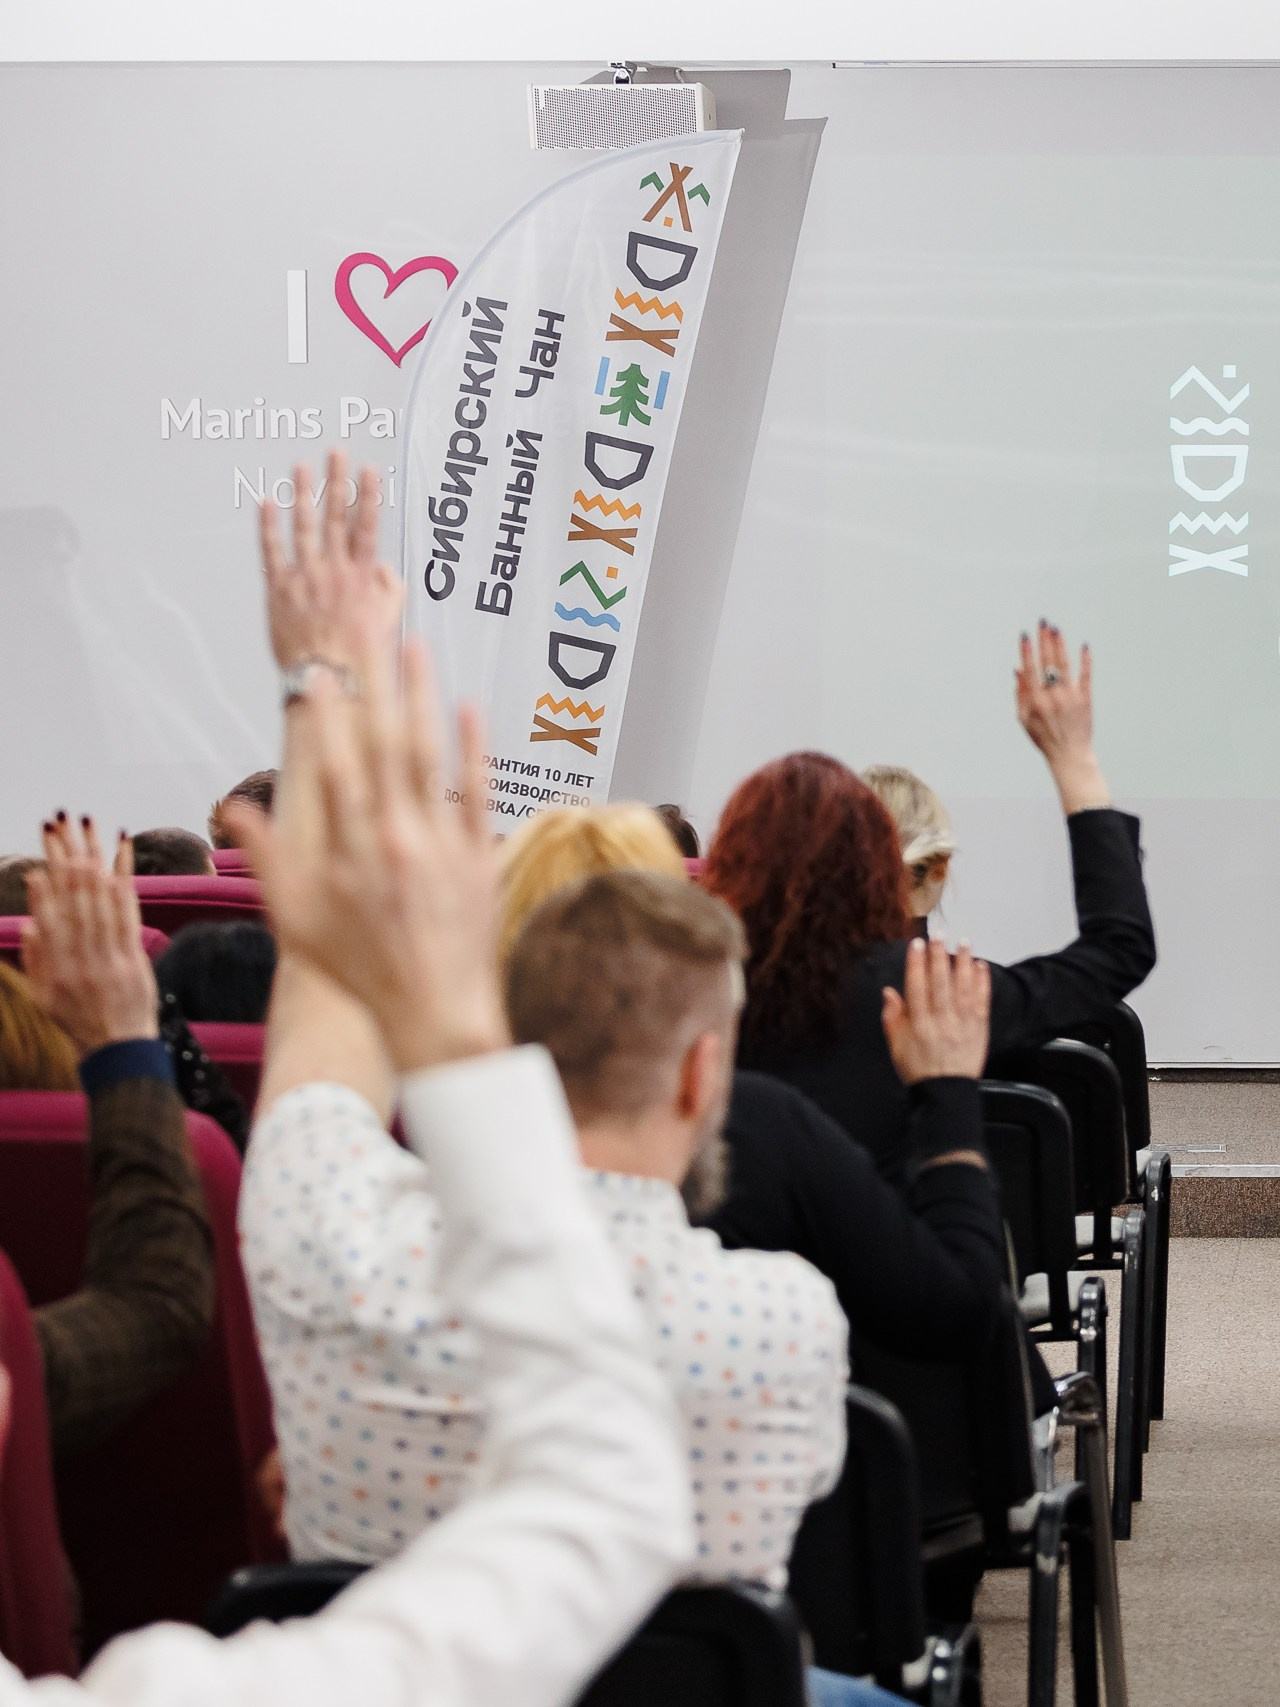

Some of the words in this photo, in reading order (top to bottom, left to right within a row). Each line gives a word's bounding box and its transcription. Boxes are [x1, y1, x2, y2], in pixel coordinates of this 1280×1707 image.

[160, 396, 322, 440] Marins
[339, 396, 404, 439] Pa
[424, 296, 508, 601] Сибирский
[475, 429, 543, 617] Банный
[515, 308, 565, 398] Чан
[466, 753, 540, 778] РАНТИЯ
[544, 768, 562, 783] 10
[564, 772, 595, 789] ЛЕТ
[480, 776, 591, 808] РОИЗВОДСТВО
